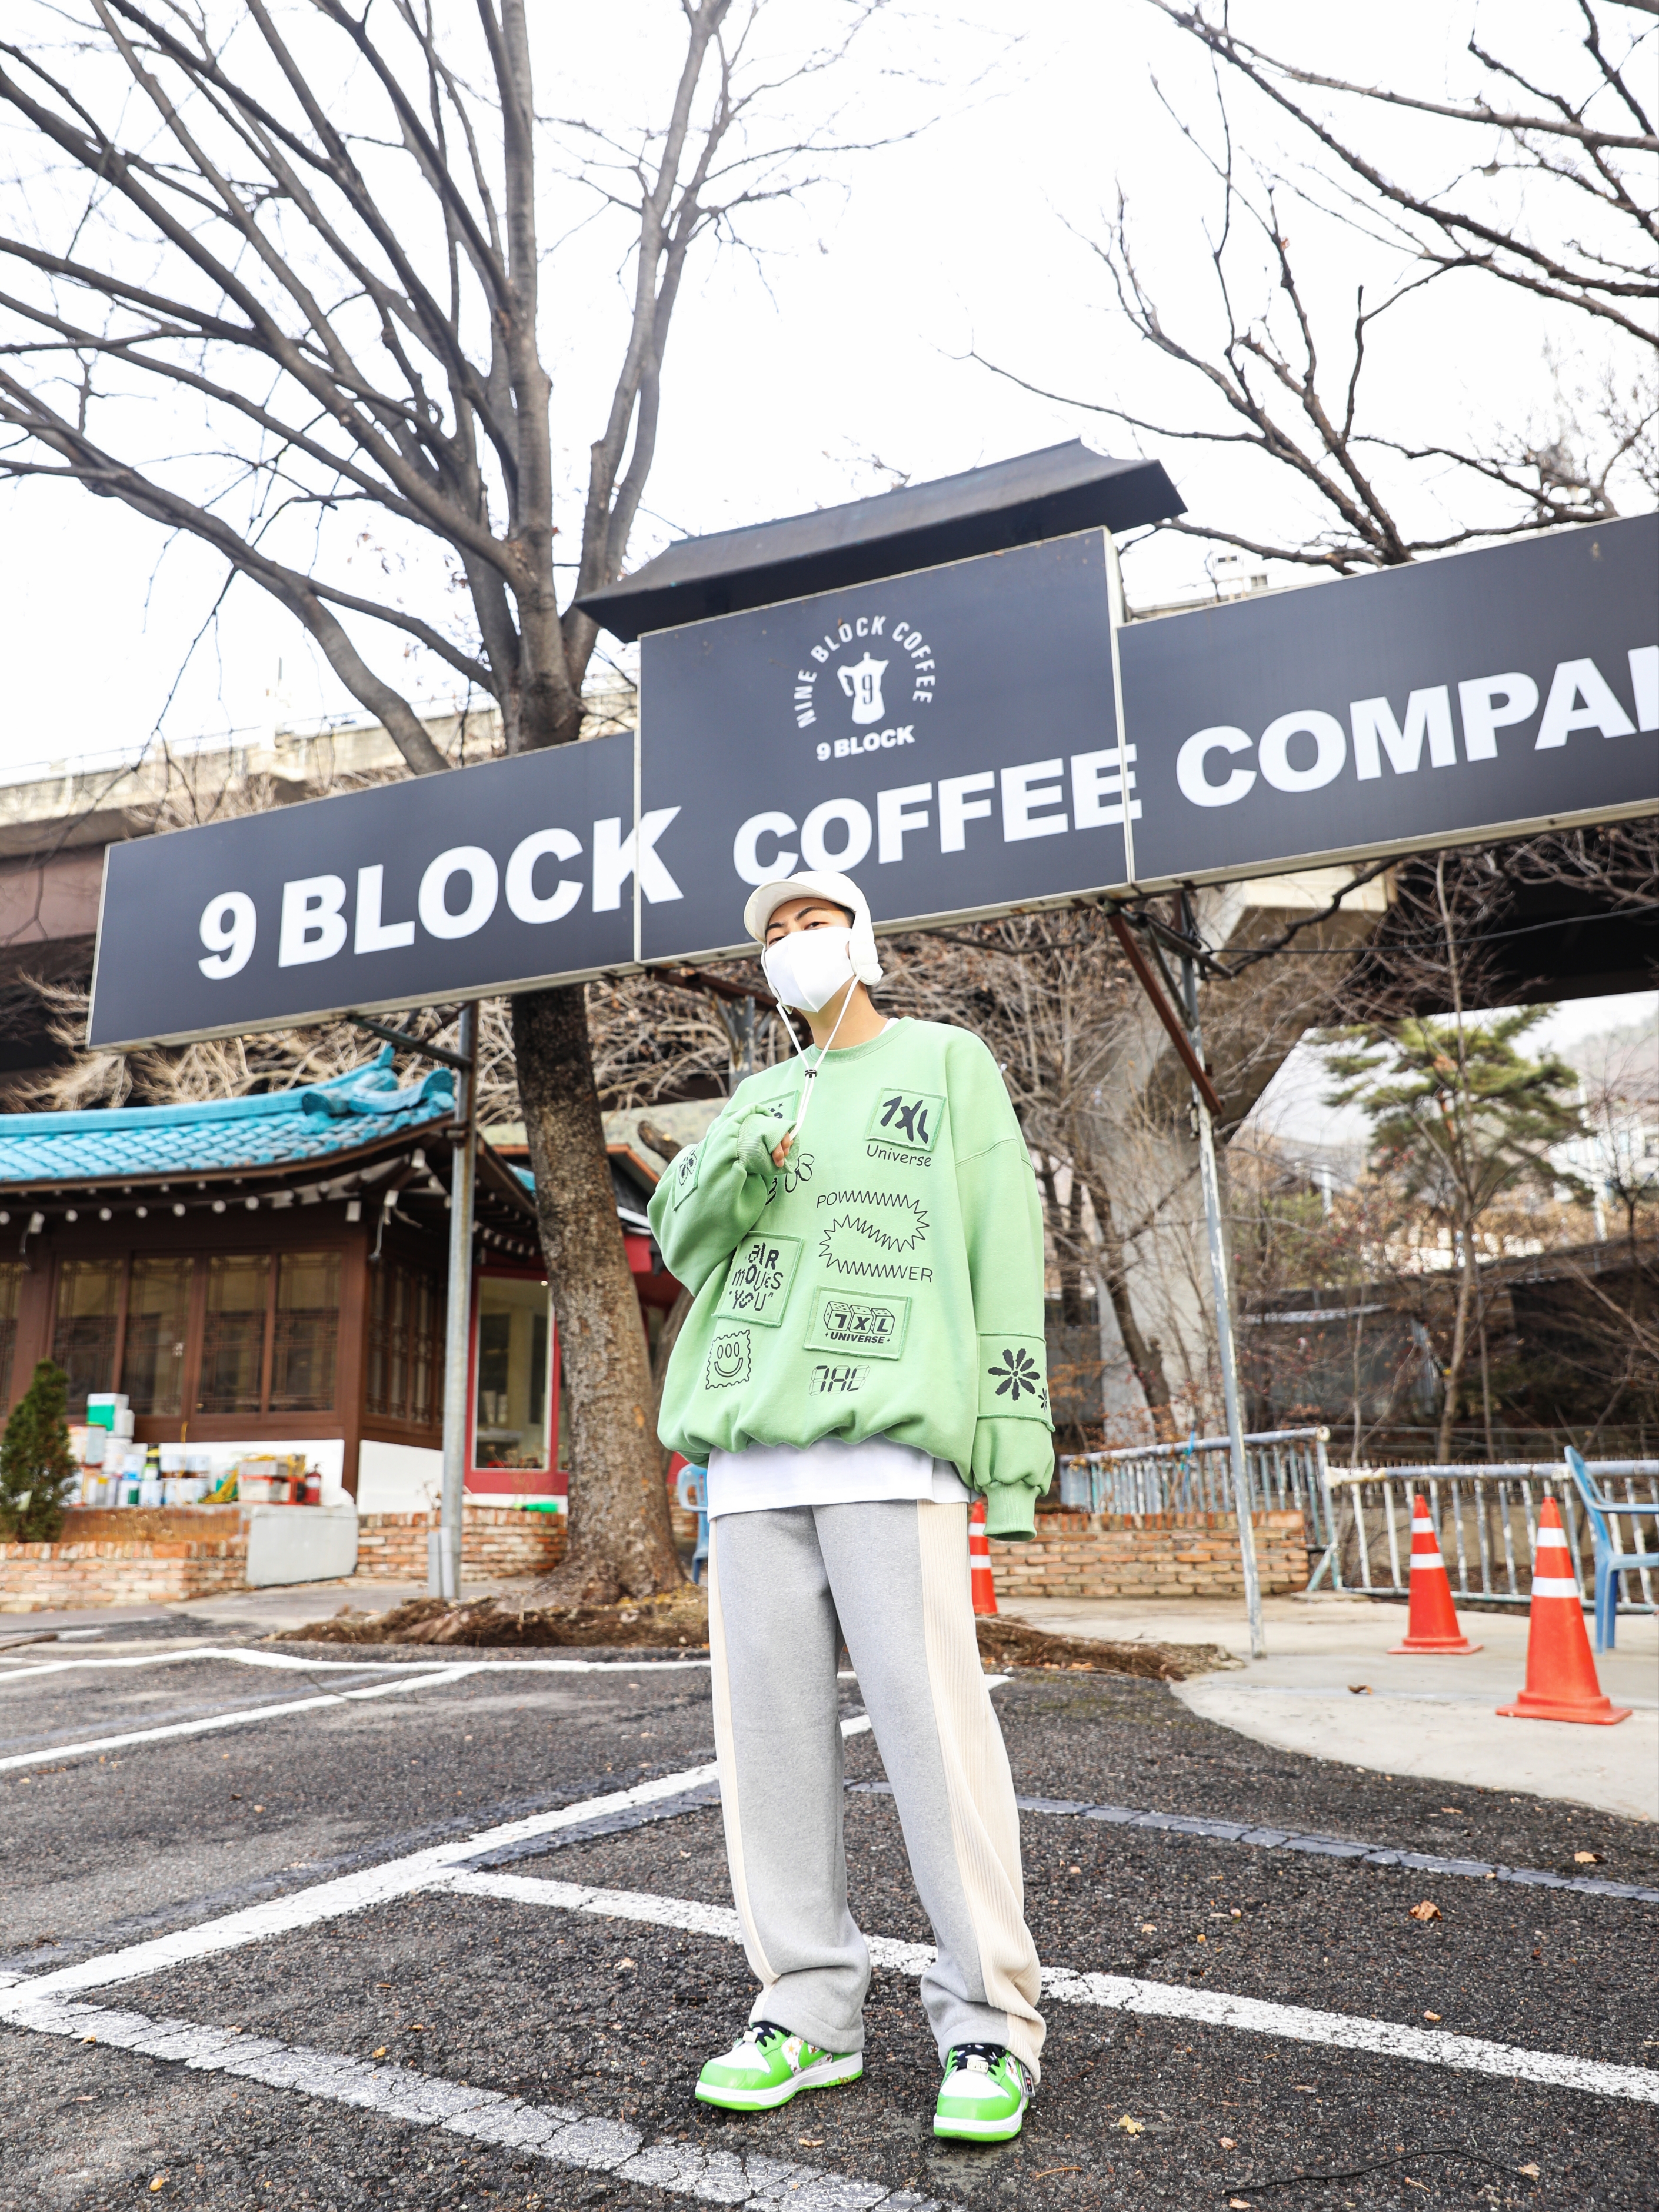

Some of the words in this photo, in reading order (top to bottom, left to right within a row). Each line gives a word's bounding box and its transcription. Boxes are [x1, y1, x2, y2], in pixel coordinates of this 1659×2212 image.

[794, 670, 817, 728] NINE
[811, 615, 886, 663] BLOCK
[892, 622, 935, 703] COFFEE
[862, 675, 873, 705] 9
[816, 742, 831, 761] 9
[834, 725, 915, 758] BLOCK
[198, 891, 257, 980] 9
[278, 805, 684, 968] BLOCK
[733, 742, 1142, 886] COFFEE
[867, 1144, 932, 1167] Universe
[830, 1331, 885, 1344] UNIVERSE
[834, 1313, 889, 1333] 7XL
